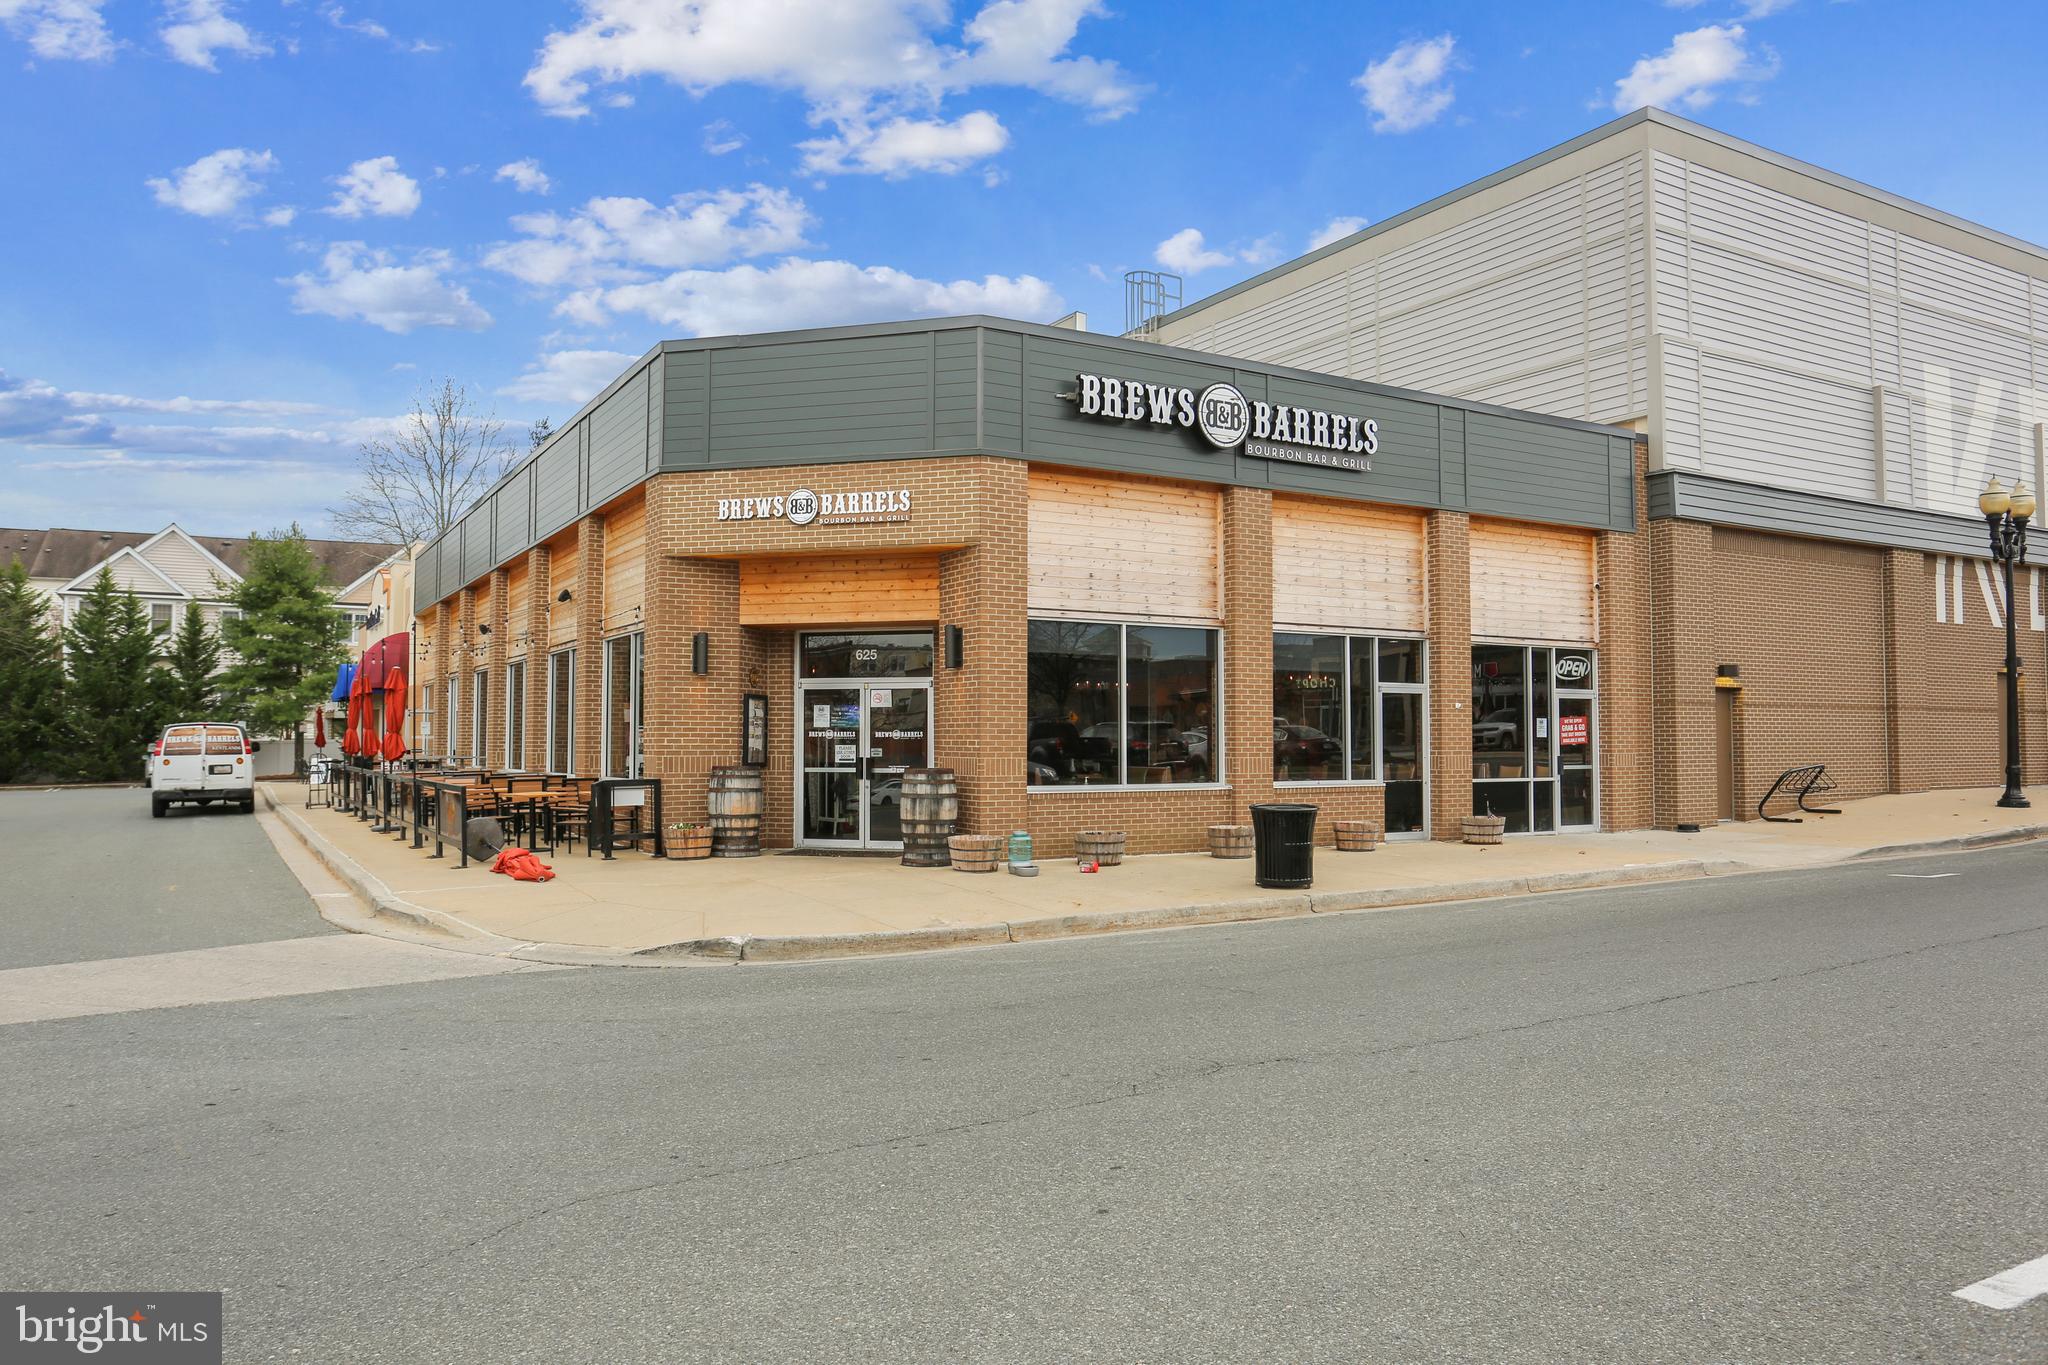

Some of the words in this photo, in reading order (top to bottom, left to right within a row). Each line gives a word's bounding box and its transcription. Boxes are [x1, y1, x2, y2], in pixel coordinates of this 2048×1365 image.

[1077, 373, 1195, 427] BREWS
[1251, 400, 1379, 455] BARRELS
[1247, 444, 1302, 461] BOURBON
[1307, 453, 1327, 465] BAR
[1331, 456, 1338, 467] &
[1342, 458, 1373, 471] GRILL
[718, 496, 784, 520] BREWS
[820, 489, 911, 515] BARRELS
[819, 517, 857, 525] BOURBON
[887, 514, 910, 522] GRILL
[855, 649, 877, 661] 625
[1557, 659, 1587, 677] OPEN
